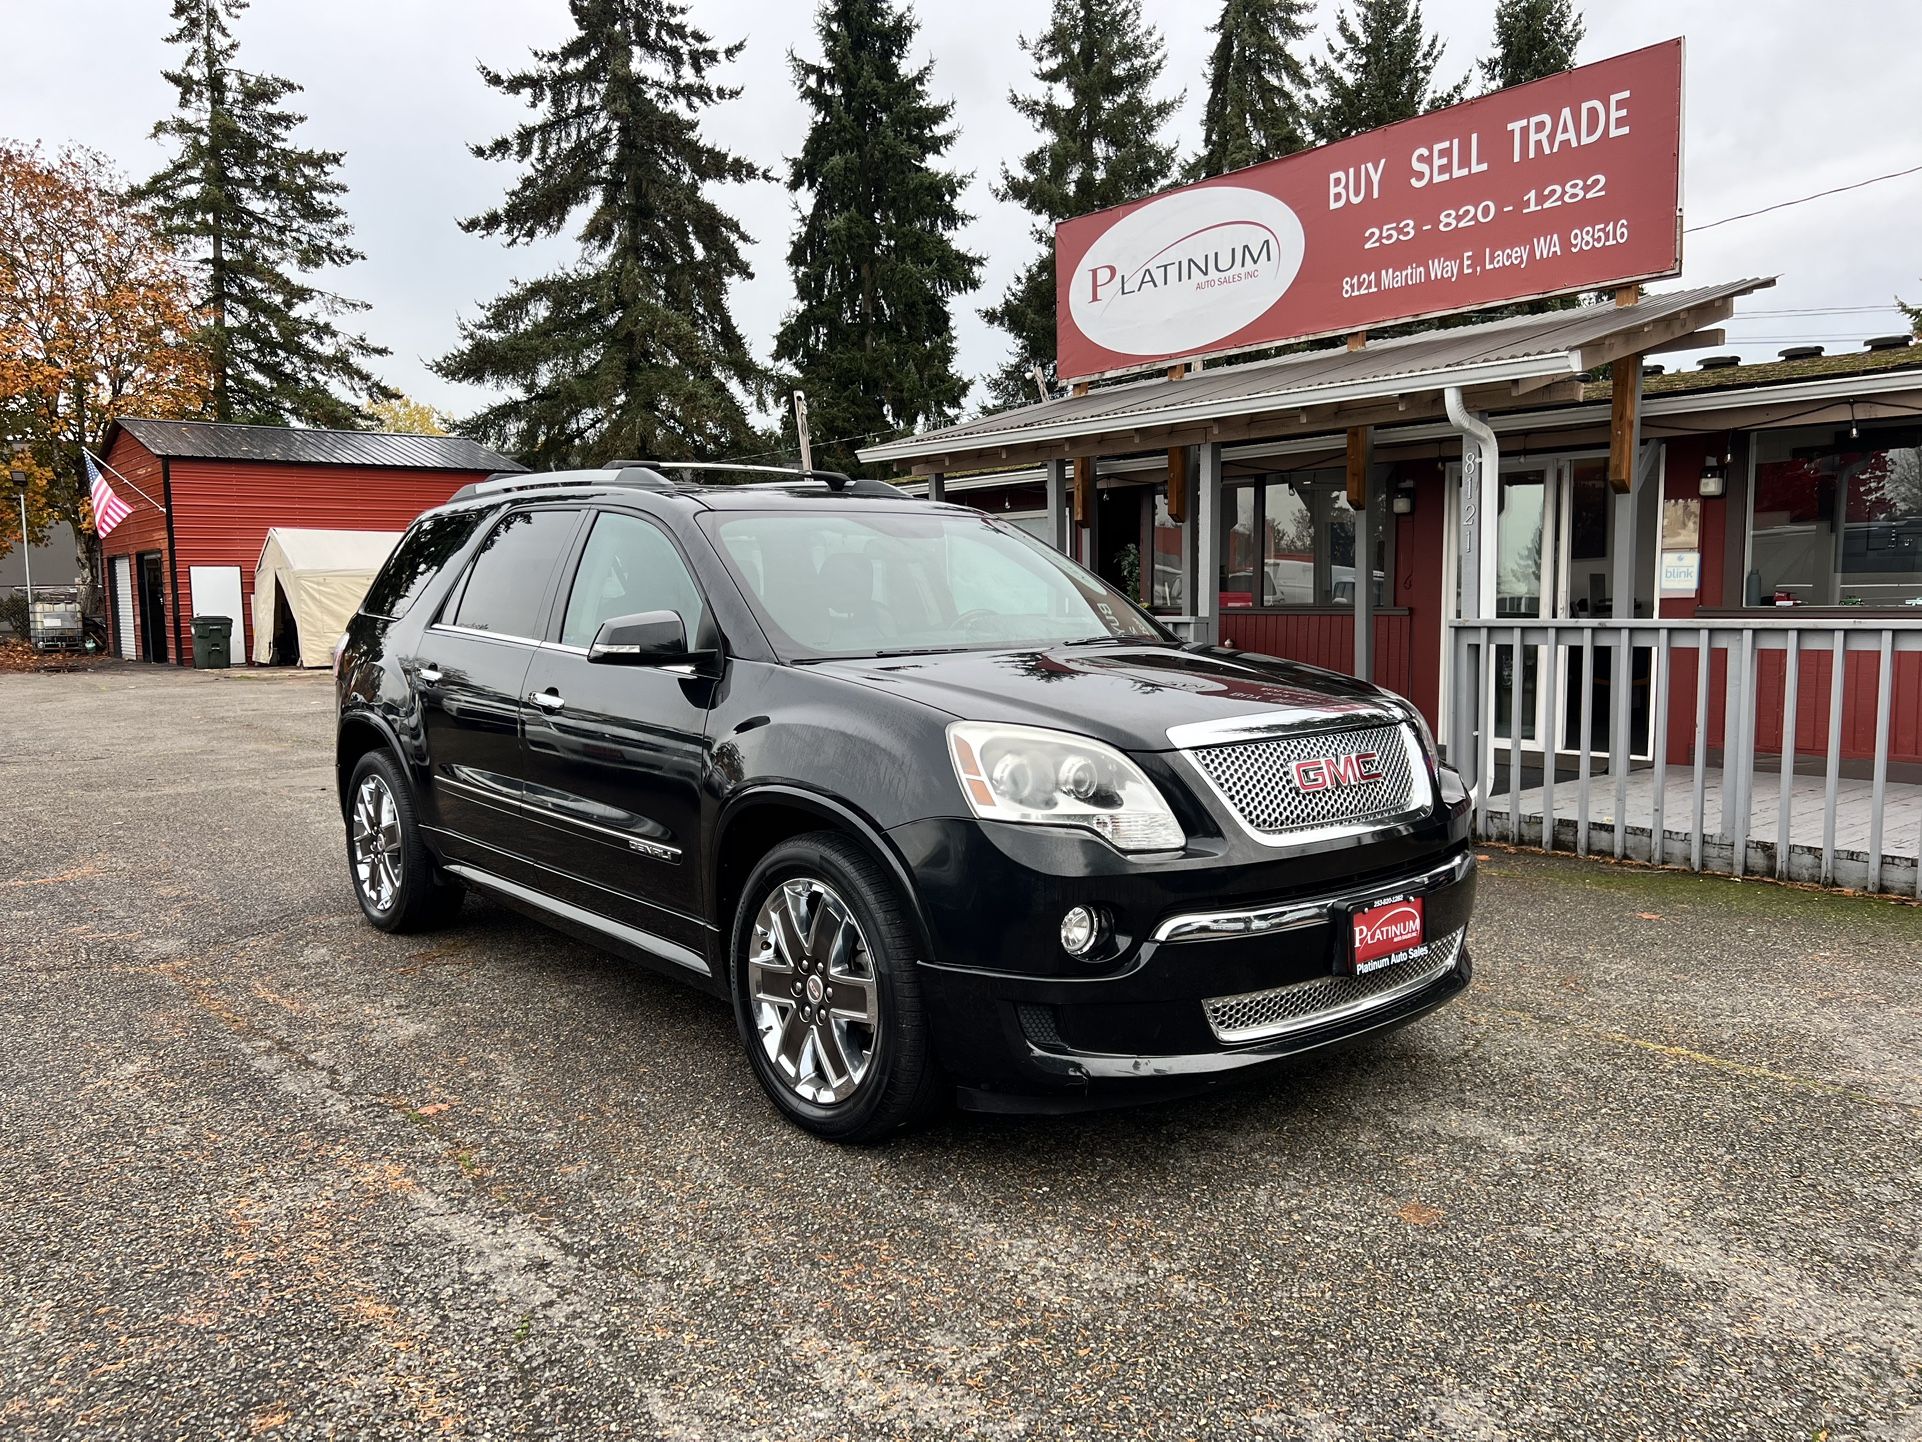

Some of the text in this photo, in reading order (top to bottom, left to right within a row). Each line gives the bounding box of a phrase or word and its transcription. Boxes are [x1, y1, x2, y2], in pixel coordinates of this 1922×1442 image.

[1329, 89, 1631, 210] BUY SELL TRADE
[1364, 219, 1415, 249] 253
[1438, 200, 1496, 232] 820
[1522, 174, 1606, 214] 1282
[1087, 239, 1272, 304] PLATINUM
[1195, 269, 1259, 291] AUTO SALES INC
[1342, 271, 1378, 298] 8121
[1381, 263, 1425, 291] Martin
[1428, 257, 1460, 282] Way
[1485, 245, 1529, 270] Lacey
[1533, 233, 1561, 260] WA
[1570, 218, 1628, 253] 98516
[1463, 452, 1477, 554] 8121
[1664, 568, 1694, 579] blink
[1293, 752, 1384, 792] GMC
[1354, 919, 1420, 948] PLATINUM
[1356, 945, 1429, 976] Platinum Auto Sales
